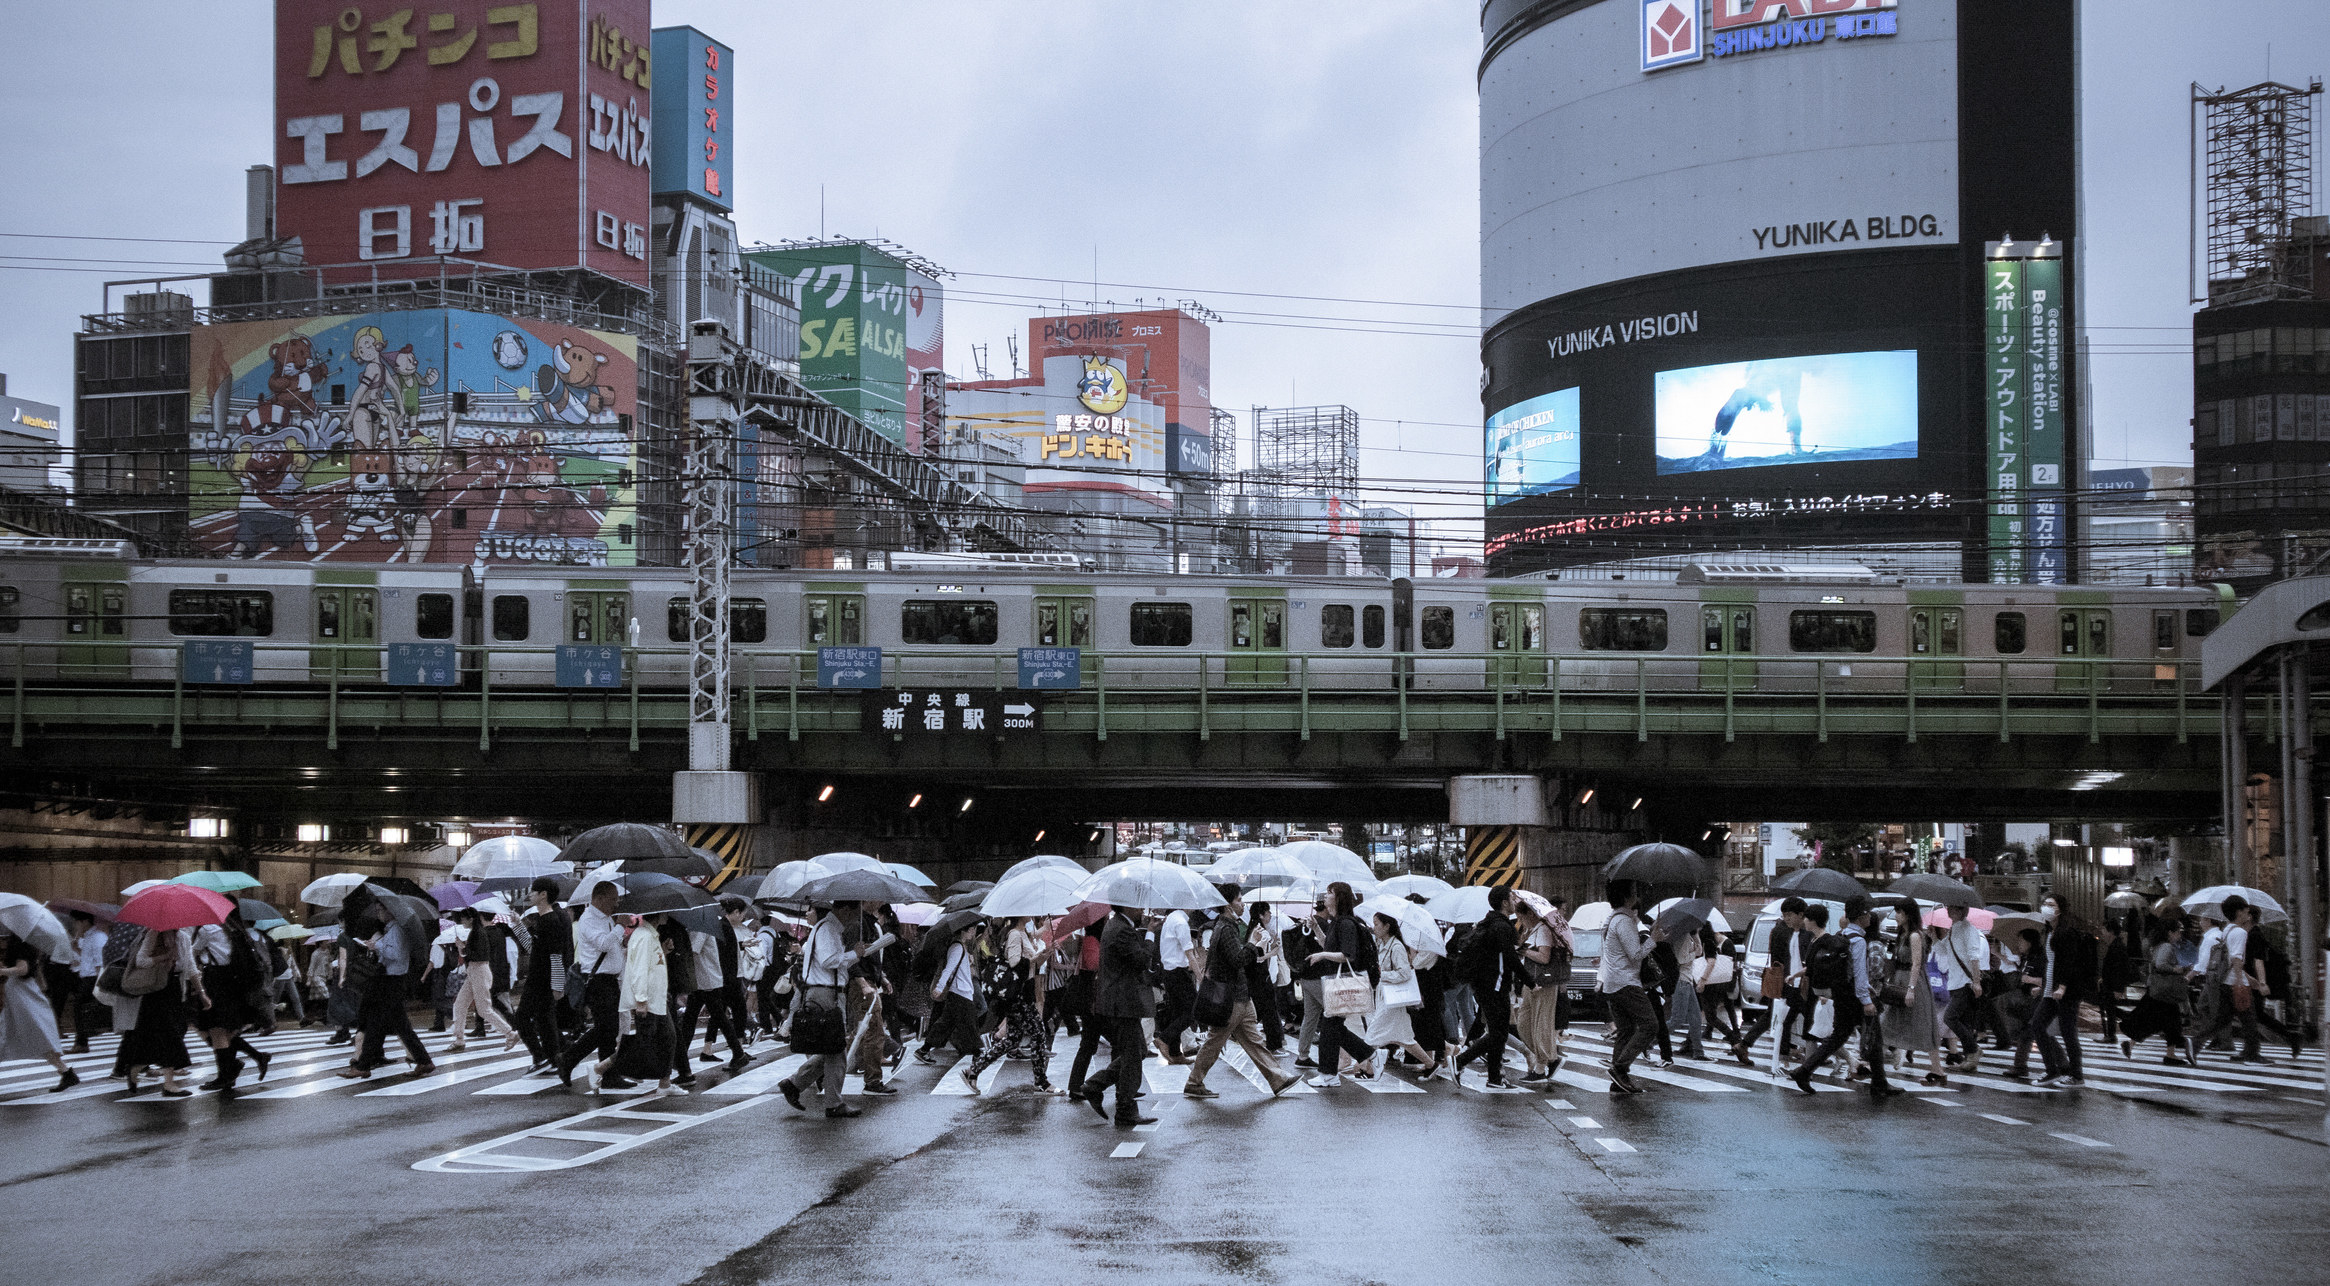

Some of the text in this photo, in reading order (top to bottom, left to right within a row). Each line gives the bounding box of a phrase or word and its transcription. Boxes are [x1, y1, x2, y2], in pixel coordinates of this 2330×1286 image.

[307, 3, 538, 78] パチンコ
[1713, 18, 1826, 56] SHINJUKU
[1835, 11, 1898, 39] 東口館
[590, 12, 651, 89] パチンコ
[282, 77, 572, 185] エスパス
[590, 92, 651, 172] エスパス
[359, 198, 484, 260] 日拓
[597, 209, 645, 261] 日拓
[1752, 214, 1944, 250] YUNIKA BLDG.
[862, 270, 904, 316] レイク
[861, 319, 905, 362] ALSA
[1131, 325, 1163, 337] プロミス
[1547, 310, 1698, 359] YUNIKA VISION
[2048, 308, 2060, 371] @cosme
[2029, 289, 2048, 430] Beauty station
[2049, 383, 2059, 412] LABI
[1520, 409, 1555, 431] CHICKEN
[1191, 442, 1209, 470] 50m
[822, 648, 877, 660] 新宿駅東口
[824, 660, 852, 668] Shinjuku
[1022, 649, 1076, 661] 新宿駅東口
[1024, 661, 1051, 669] Shinjuku
[898, 692, 971, 707] 中央線
[882, 707, 985, 730] 新宿駅
[1004, 718, 1034, 729] 300M
